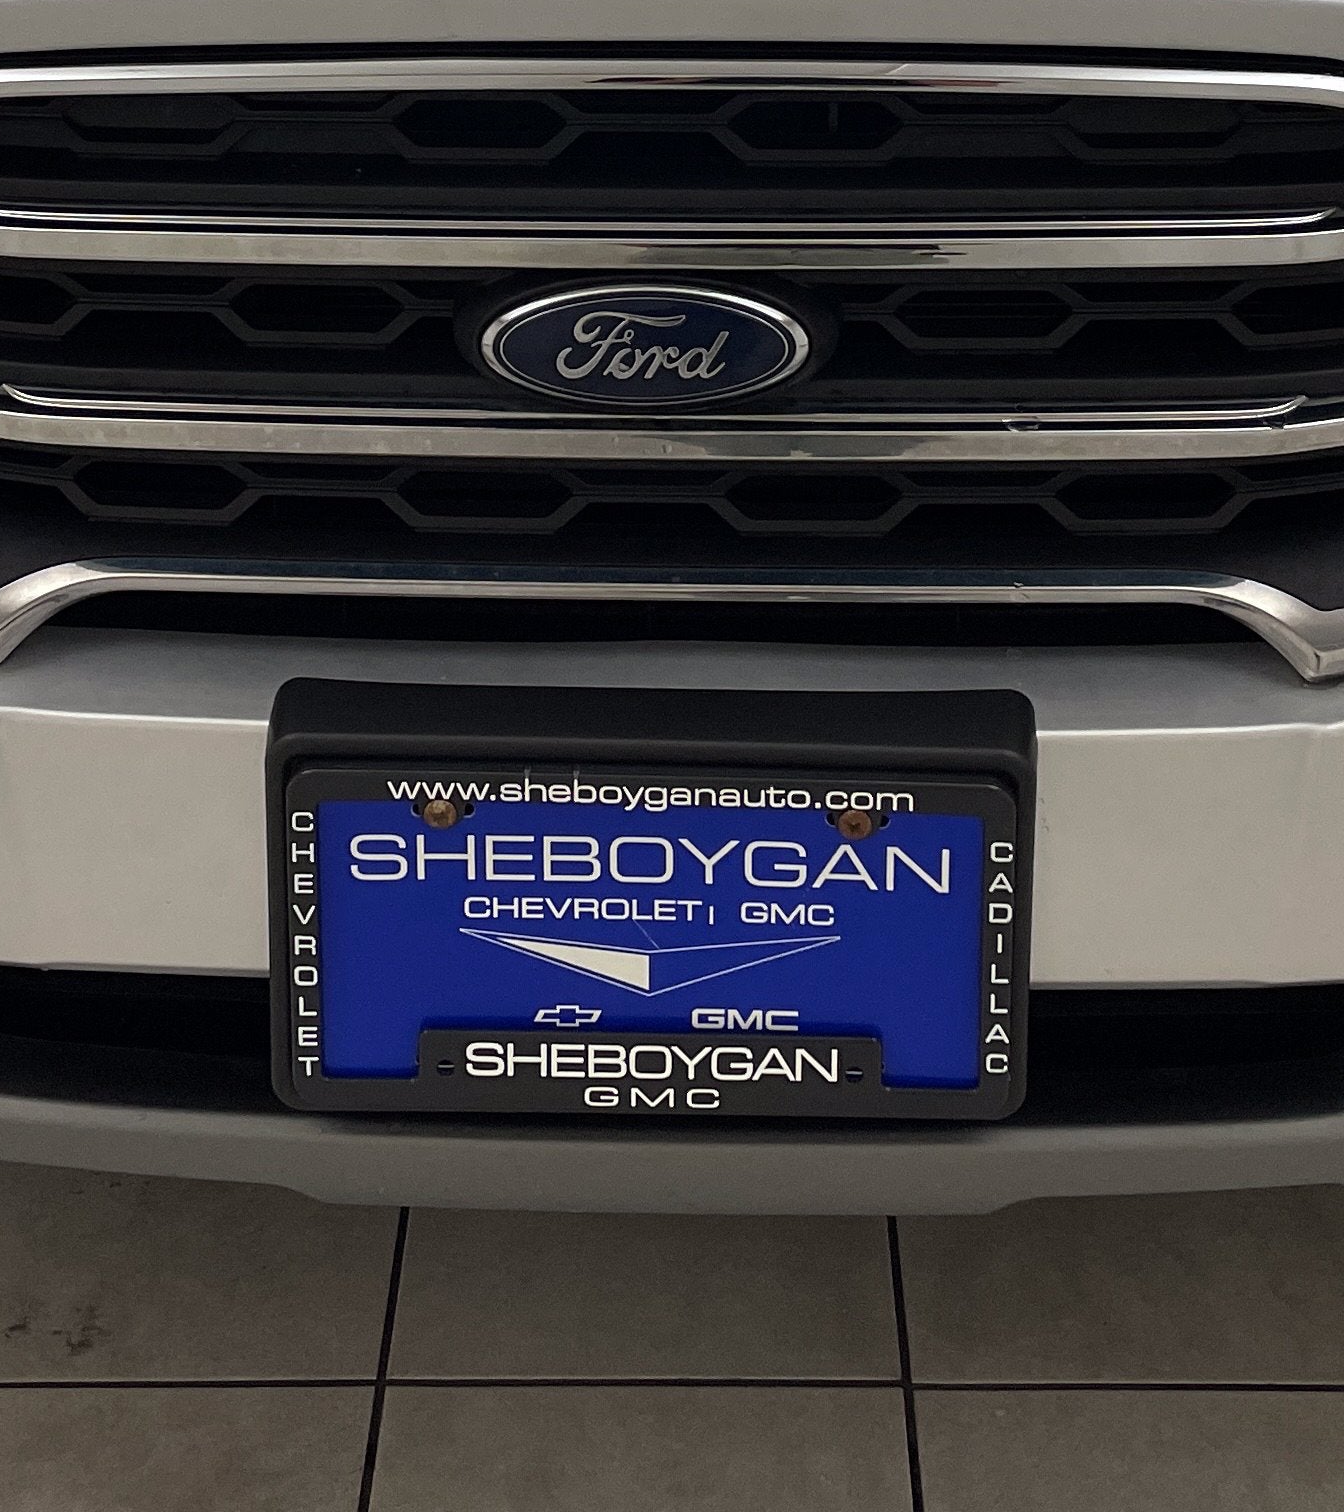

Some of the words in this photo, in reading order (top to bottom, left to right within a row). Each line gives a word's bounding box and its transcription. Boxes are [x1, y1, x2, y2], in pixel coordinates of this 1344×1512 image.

[556, 311, 730, 380] Ford
[387, 778, 914, 812] www.sheboyganauto.com
[350, 834, 950, 894] SHEBOYGAN
[463, 896, 703, 921] CHEVROLET
[741, 902, 835, 926] GMC
[291, 812, 319, 1077] CHEVROLET
[984, 842, 1013, 1074] CADILLAC
[691, 1008, 799, 1031] GMC
[465, 1041, 838, 1082] SHEBOYGAN
[584, 1086, 720, 1109] GMC
